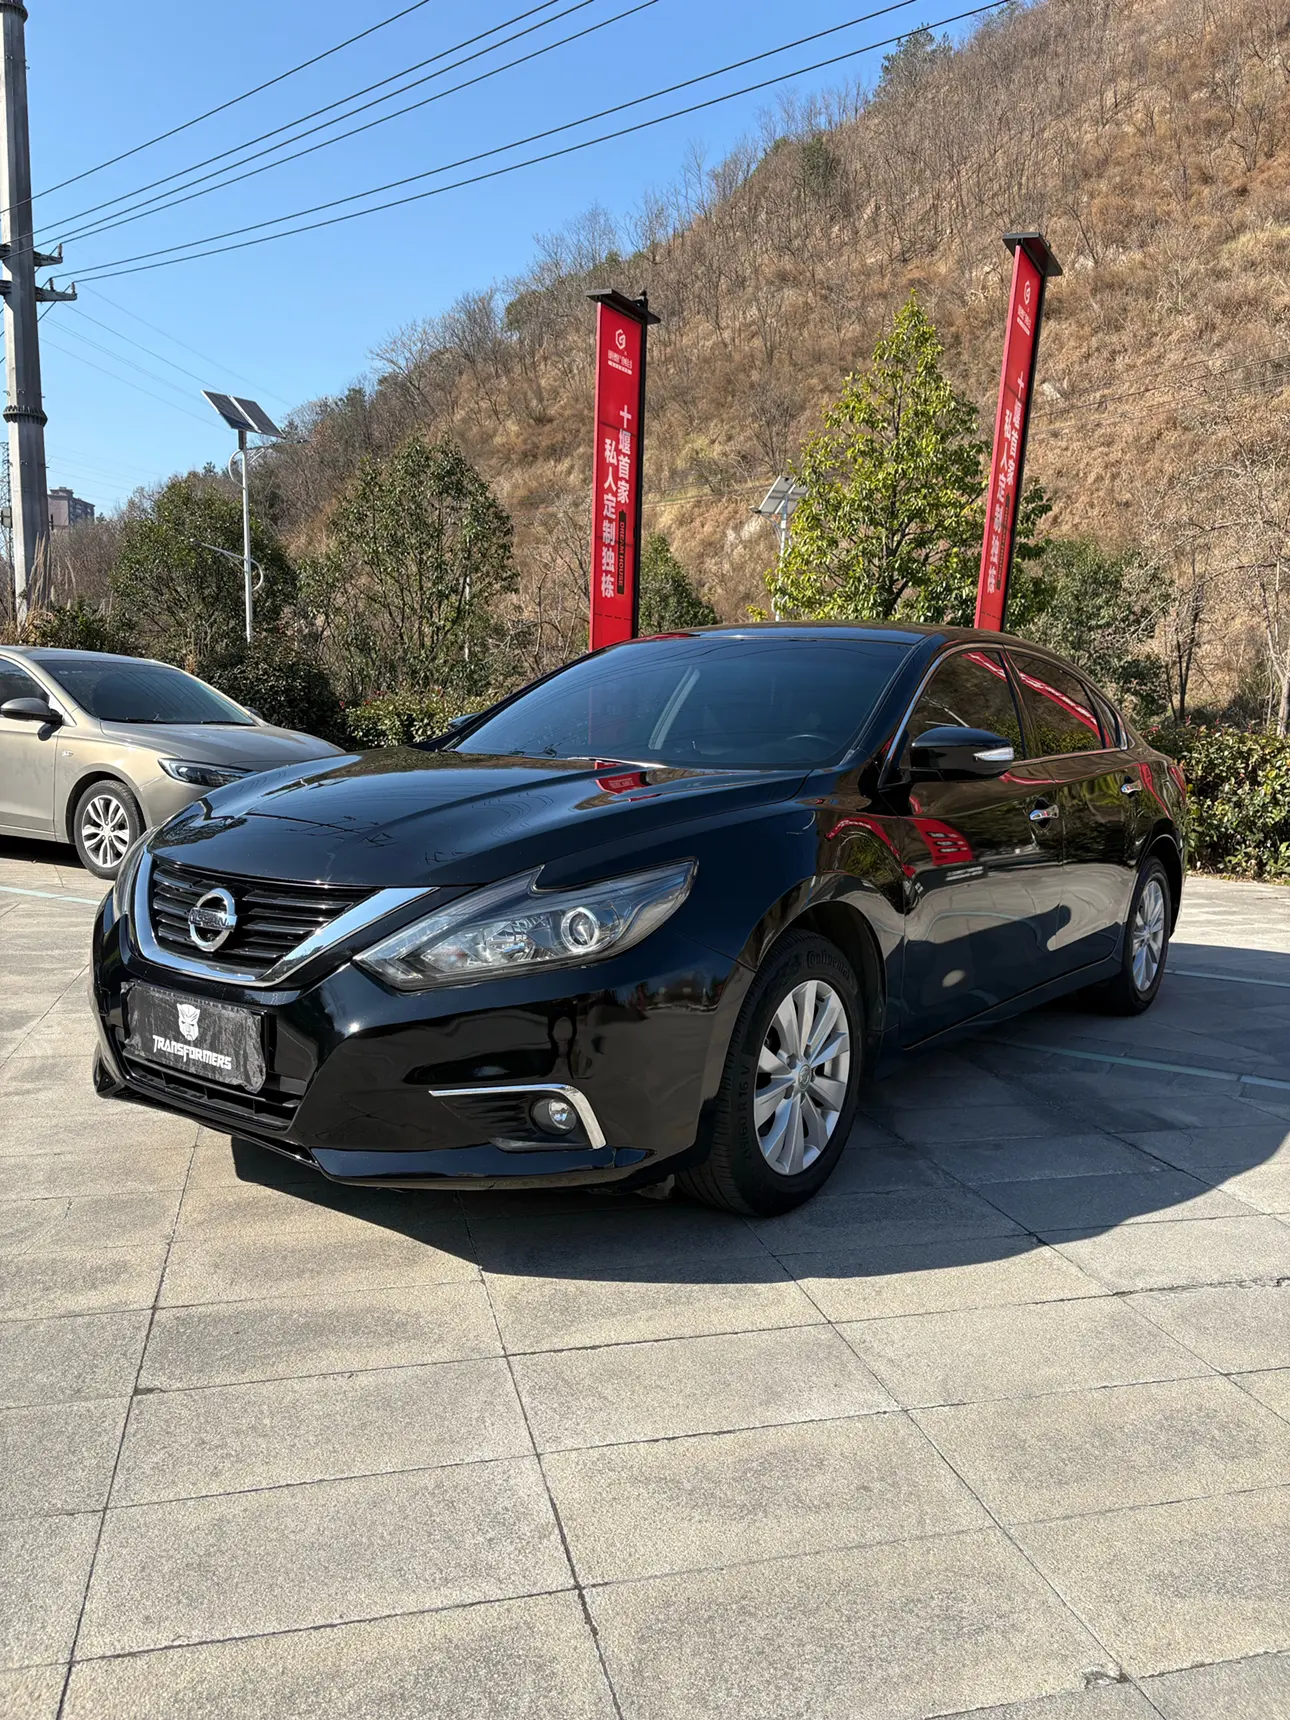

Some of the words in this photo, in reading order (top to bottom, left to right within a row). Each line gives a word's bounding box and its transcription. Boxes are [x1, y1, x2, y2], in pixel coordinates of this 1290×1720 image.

[617, 404, 632, 504] 十堰首家
[601, 438, 617, 599] 私人定制独栋
[807, 950, 849, 980] Continental
[153, 1035, 232, 1070] TRANSFORMERS
[738, 1082, 749, 1098] 16
